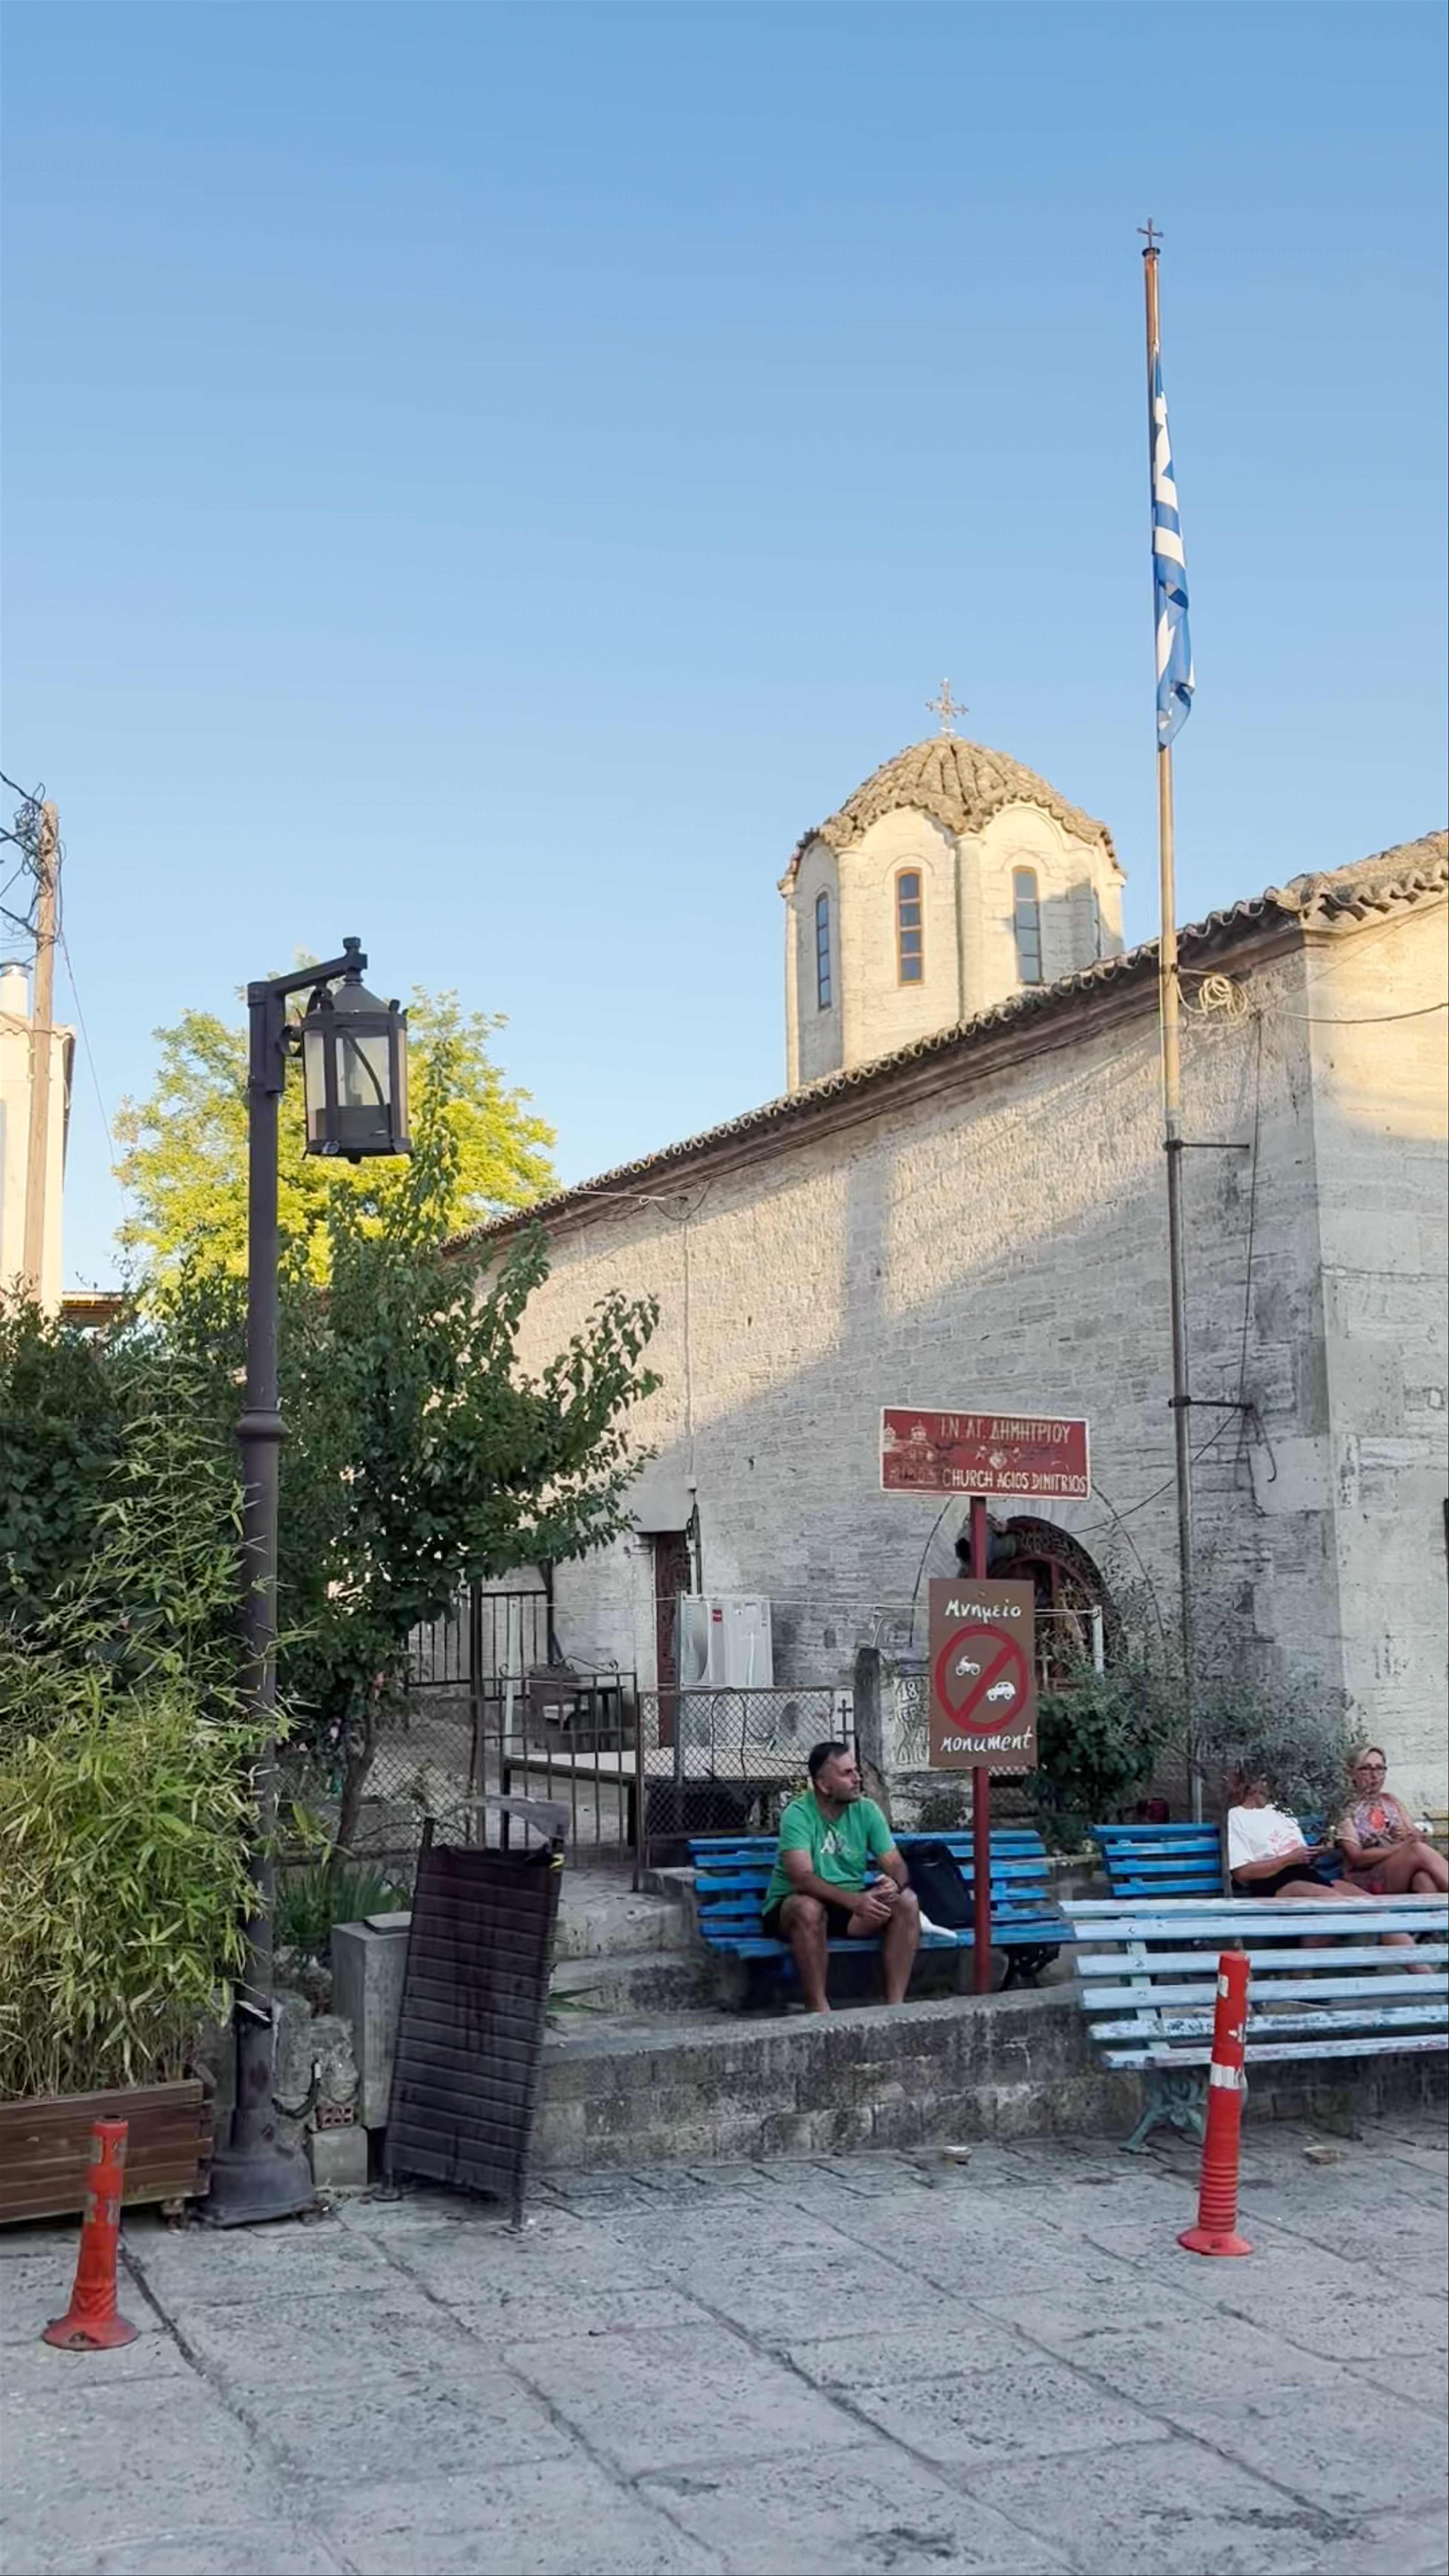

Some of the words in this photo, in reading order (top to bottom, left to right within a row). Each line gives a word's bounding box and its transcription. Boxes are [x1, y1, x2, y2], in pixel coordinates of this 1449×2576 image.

[989, 1419, 1071, 1444] ΔΗΜΗΤΡΙΟΥ
[943, 1468, 993, 1488] CHURCH
[997, 1470, 1029, 1490] AGIOS
[1031, 1473, 1086, 1493] DIMITRIOS
[940, 1726, 1033, 1752] monument
